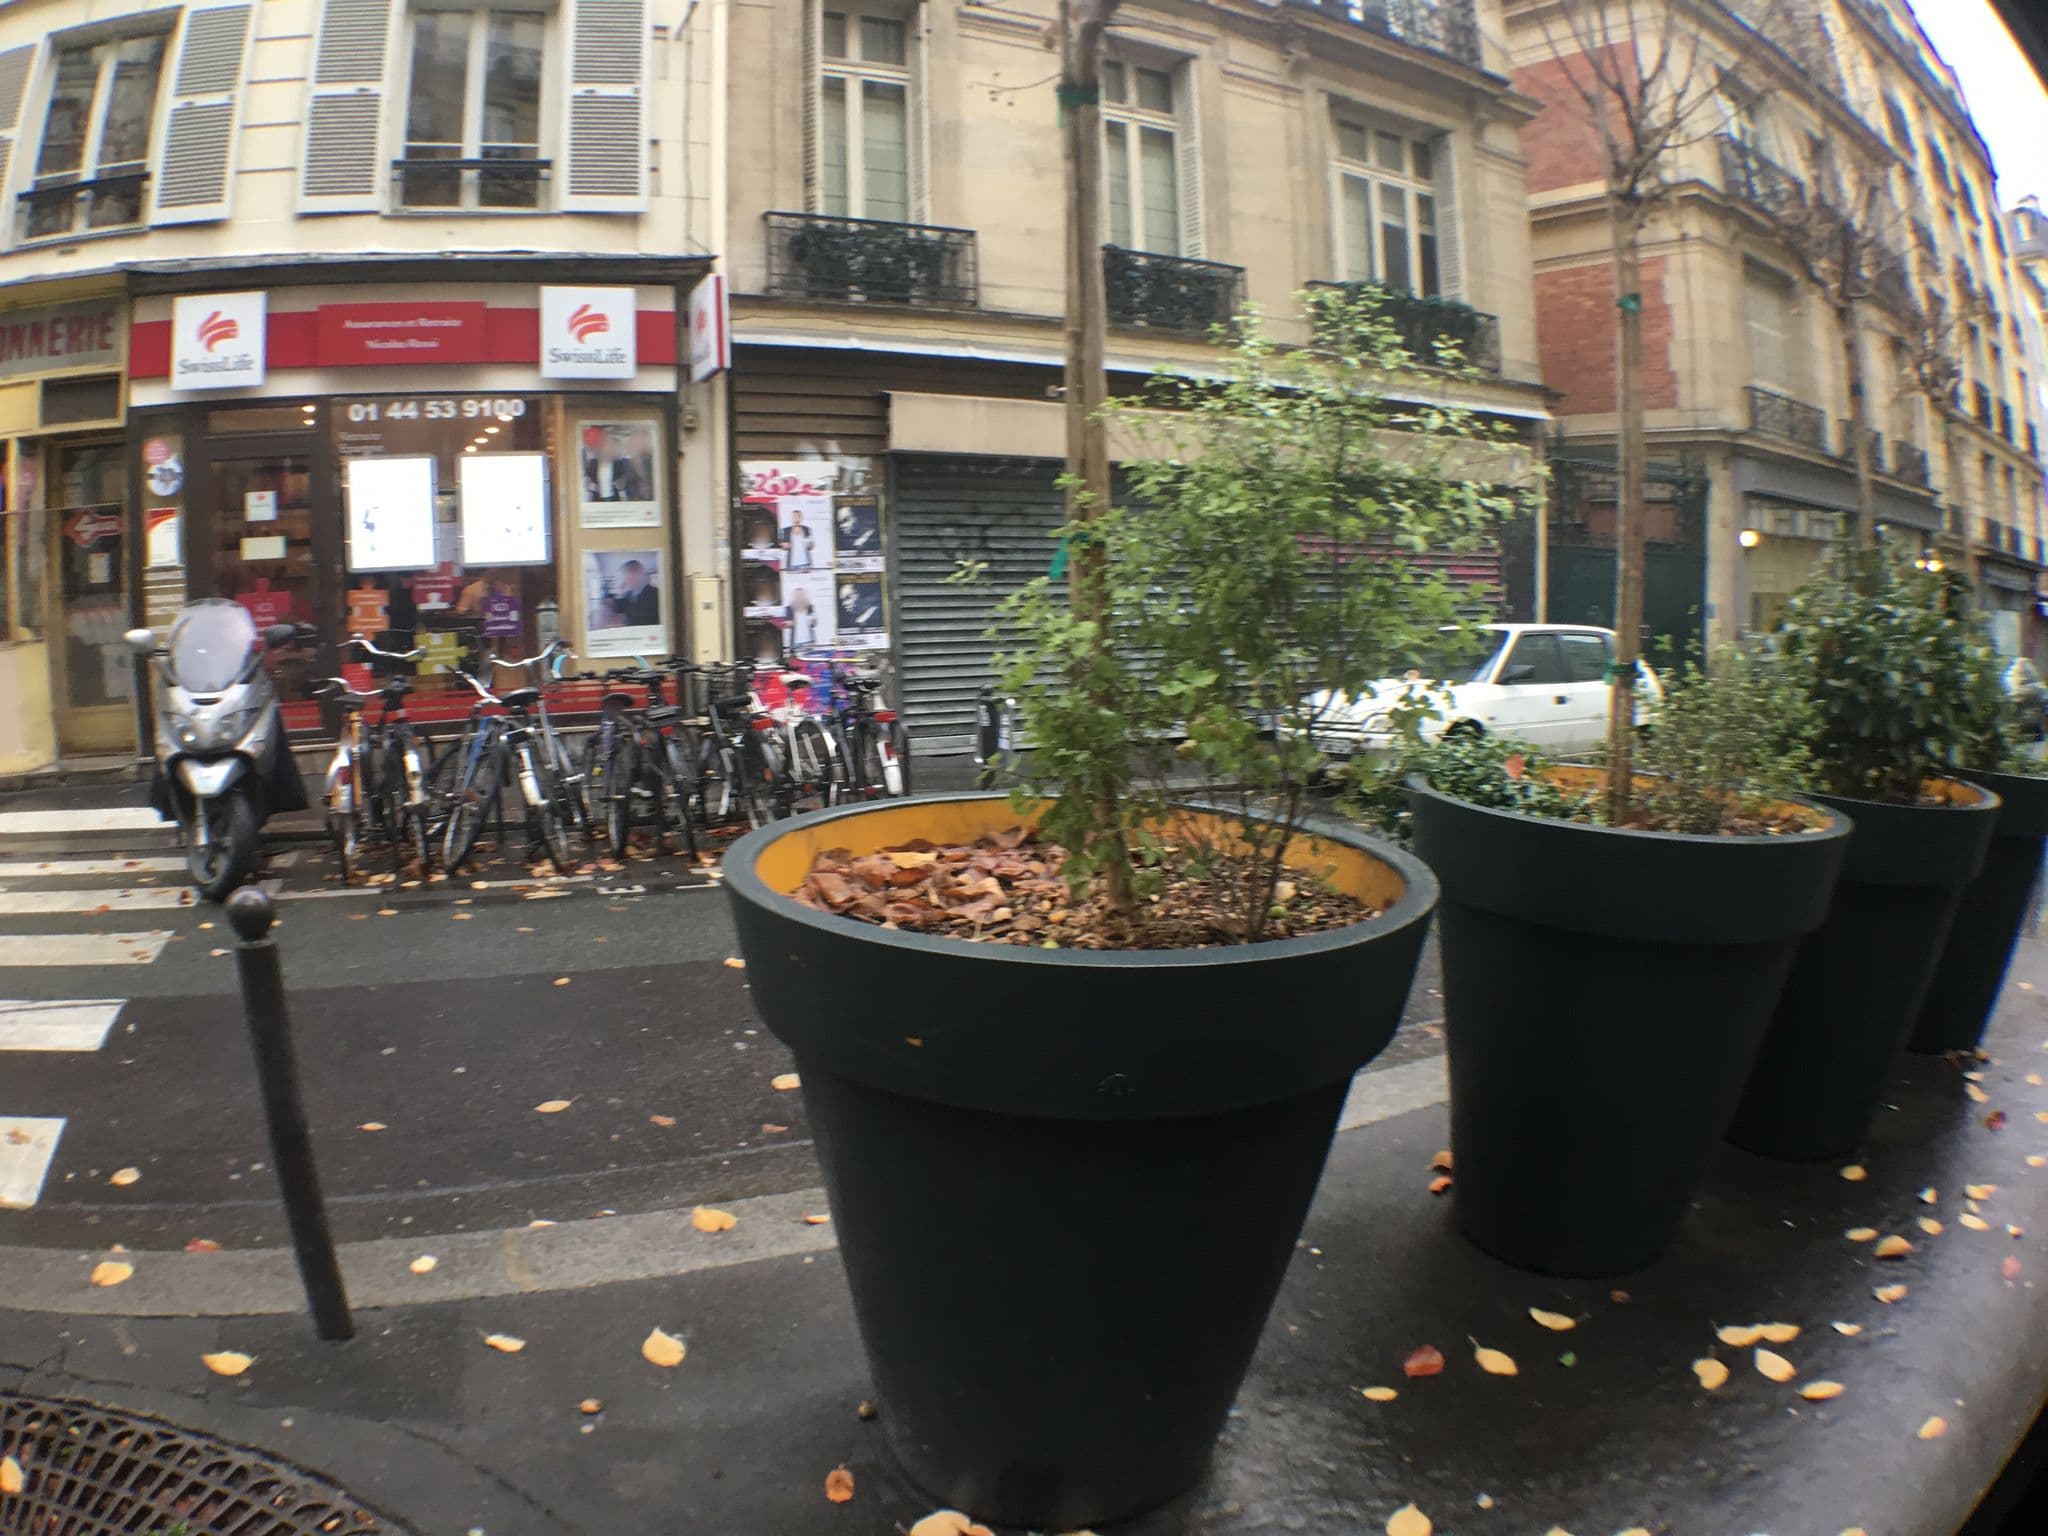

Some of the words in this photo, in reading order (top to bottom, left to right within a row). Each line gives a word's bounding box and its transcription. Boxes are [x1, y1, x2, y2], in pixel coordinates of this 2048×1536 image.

[177, 353, 256, 375] SwissLife
[548, 347, 627, 364] SwissLife
[348, 402, 379, 422] 01
[385, 401, 420, 420] 44
[424, 399, 458, 419] 53
[461, 397, 526, 418] 9100
